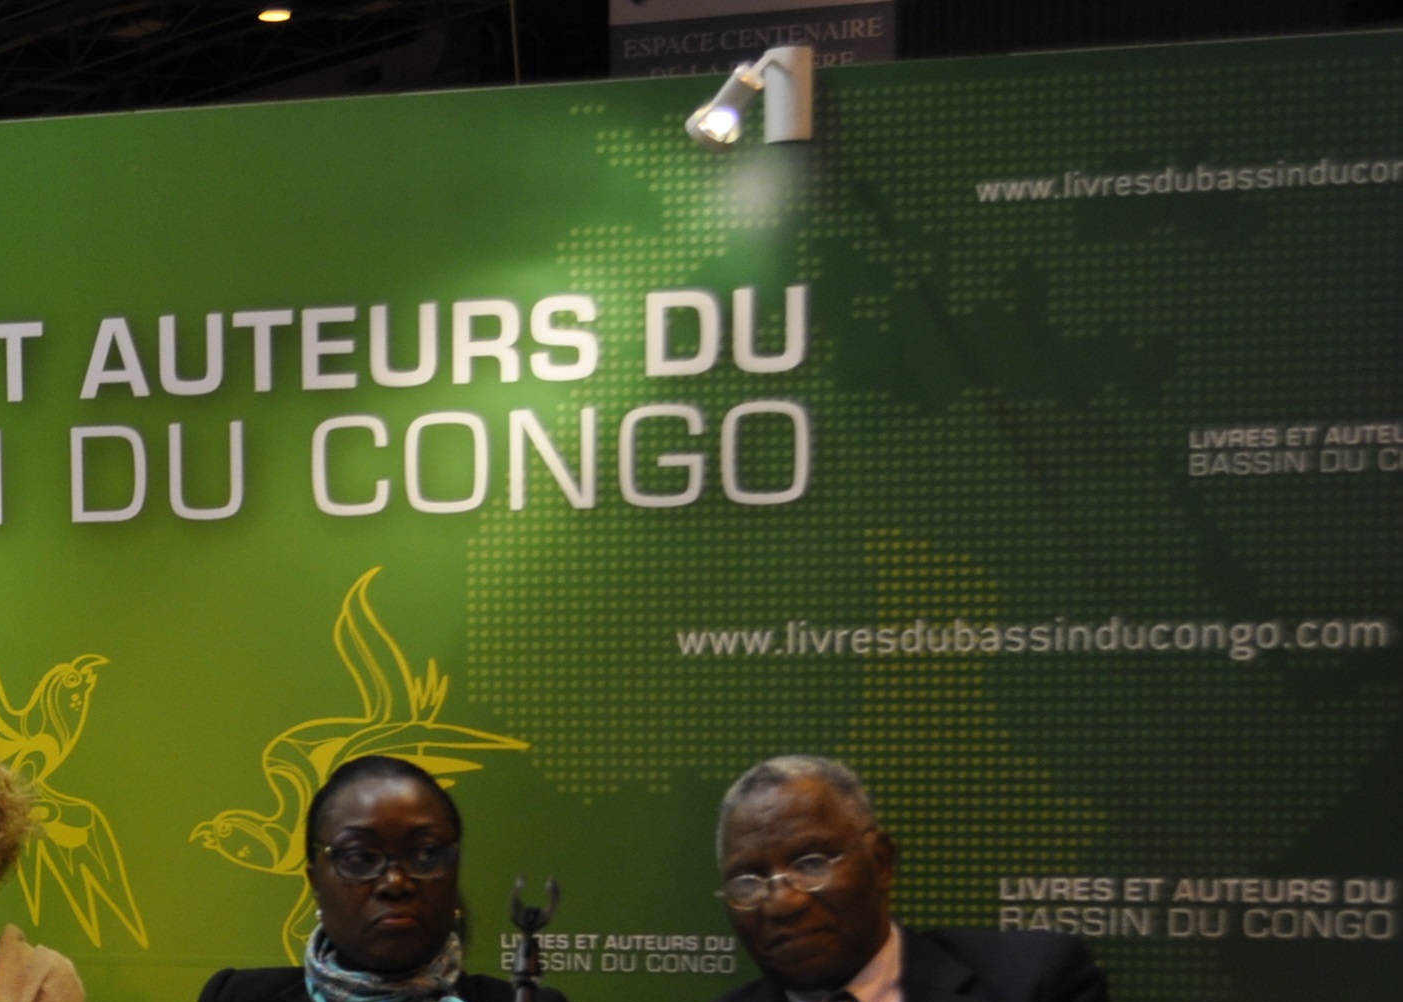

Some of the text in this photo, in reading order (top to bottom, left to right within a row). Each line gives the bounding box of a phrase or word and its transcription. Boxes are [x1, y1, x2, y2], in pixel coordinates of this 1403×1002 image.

[720, 16, 884, 50] CENTENAIRE
[79, 294, 598, 399] AUTEURS
[645, 285, 807, 378] DU
[1188, 427, 1278, 448] LIVRES
[1286, 426, 1317, 446] ET
[70, 420, 244, 523] DU
[310, 400, 808, 518] CONGO
[1188, 450, 1307, 477] BASSIN
[1320, 448, 1366, 473] DU
[677, 617, 1388, 660] www.livresdubassinducongo.com
[999, 877, 1394, 904] LIVRES ET AUTEURS DU
[1168, 908, 1227, 938] DU
[1242, 909, 1394, 940] CONGO
[575, 934, 598, 949] ET
[604, 935, 698, 951] AUTEURS
[705, 936, 735, 952] DU
[501, 952, 736, 974] BSSIN DU CONGO
